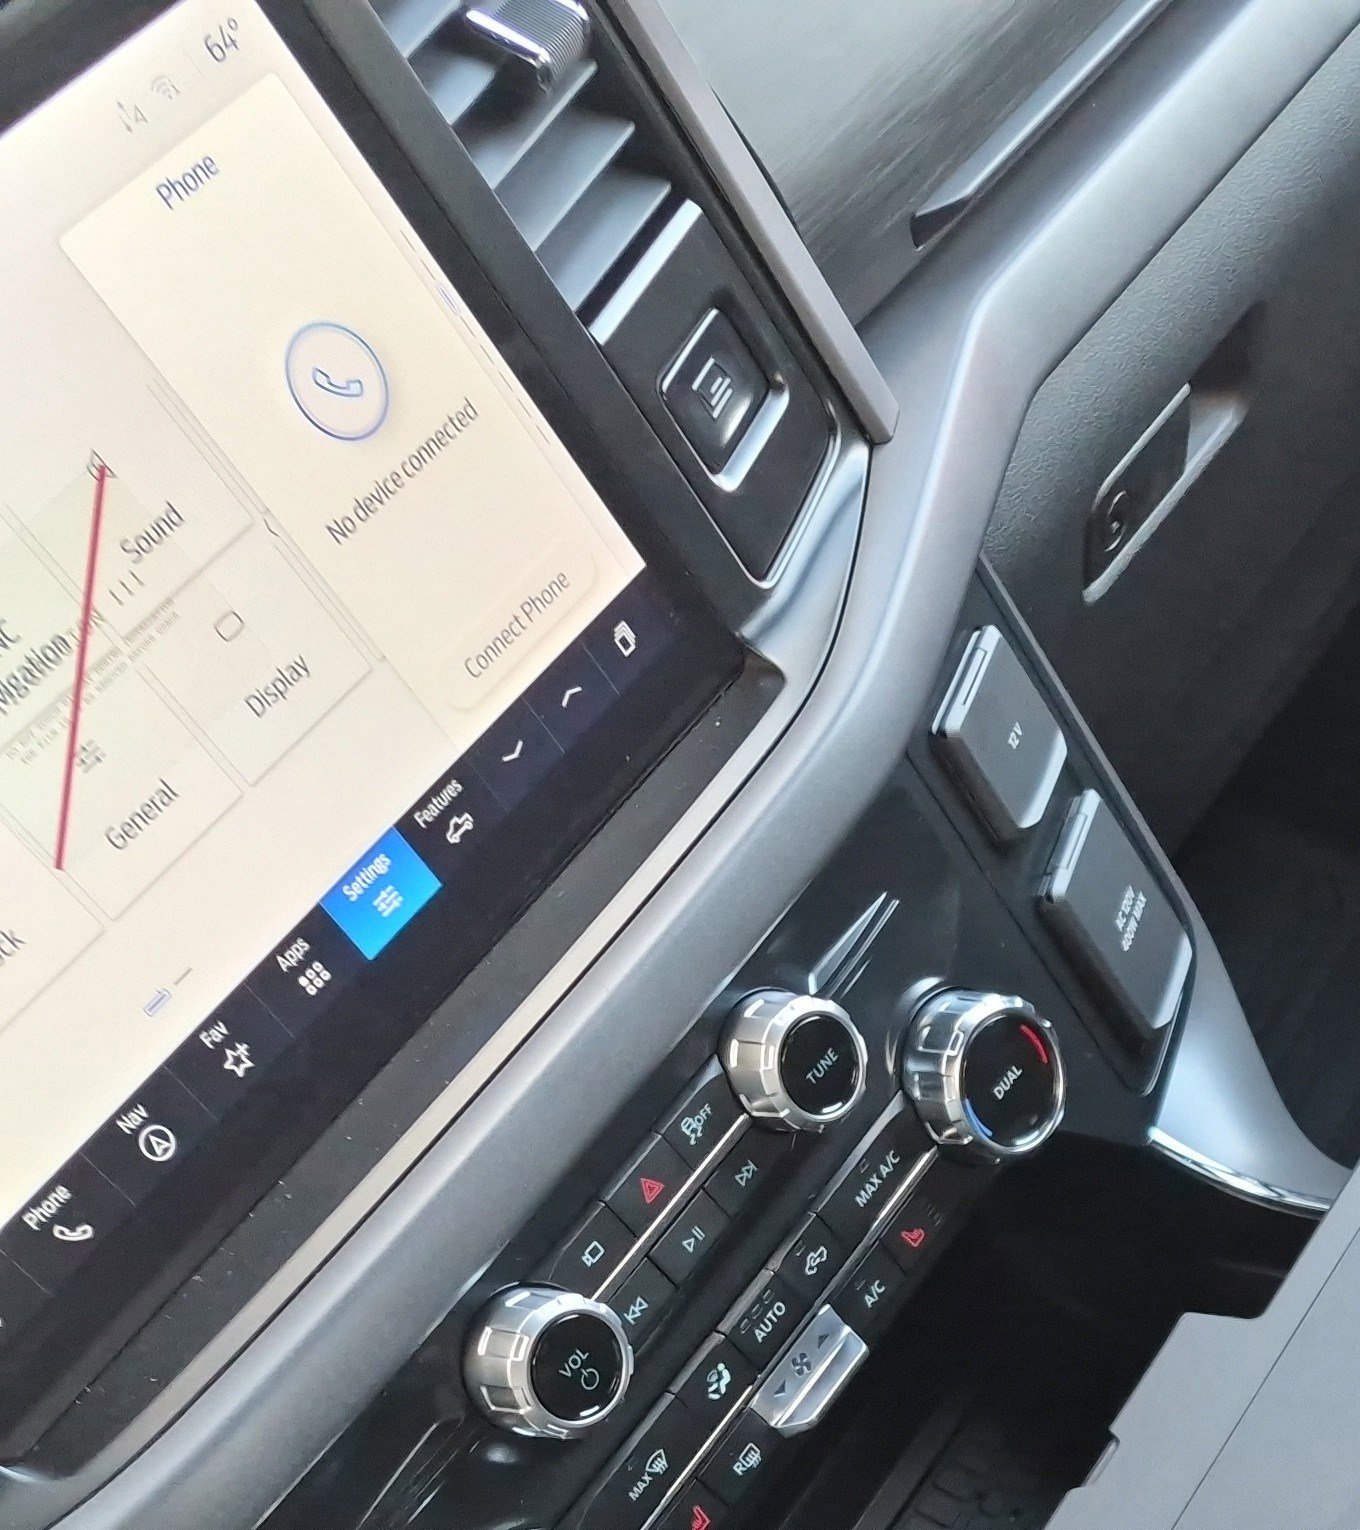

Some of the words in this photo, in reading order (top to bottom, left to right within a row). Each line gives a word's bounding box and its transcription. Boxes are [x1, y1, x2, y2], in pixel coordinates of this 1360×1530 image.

[155, 151, 220, 211] Phone
[324, 515, 357, 546] No
[353, 471, 405, 523] device
[400, 396, 479, 479] connected
[119, 500, 186, 565] Sound
[464, 609, 527, 680] Connect
[521, 571, 571, 623] Phone
[243, 653, 313, 719] Display
[104, 776, 181, 851] General
[413, 777, 463, 829] Features
[342, 853, 392, 902] Settings
[275, 937, 312, 973] Apps
[199, 1019, 231, 1050] Fav
[805, 1047, 840, 1085] TUNE
[992, 1064, 1024, 1101] DUAL
[115, 1102, 151, 1135] Nav
[693, 1102, 713, 1127] OFF
[854, 1170, 883, 1208] MAX
[878, 1150, 901, 1180] A/C
[22, 1184, 74, 1232] Phone
[863, 1278, 887, 1309] A/C
[753, 1300, 787, 1344] AUTO
[558, 1347, 590, 1379] VOL
[627, 1474, 653, 1502] MAX
